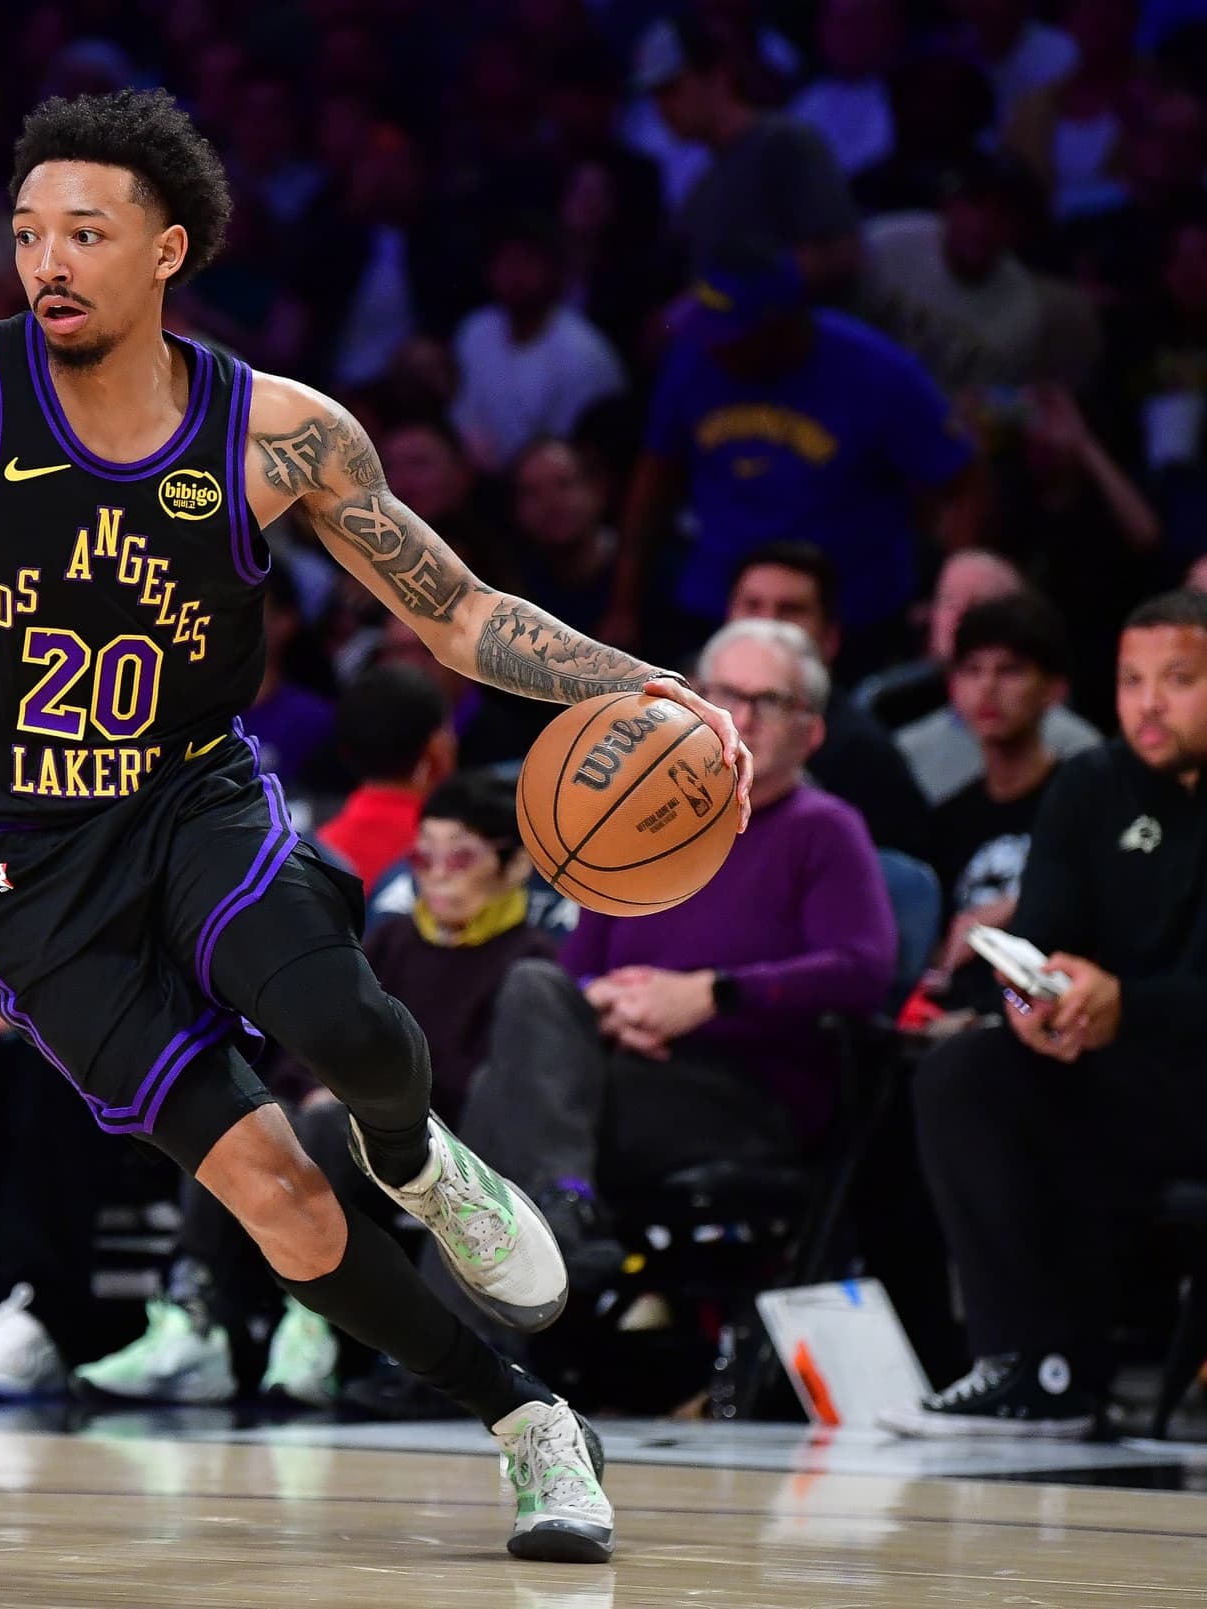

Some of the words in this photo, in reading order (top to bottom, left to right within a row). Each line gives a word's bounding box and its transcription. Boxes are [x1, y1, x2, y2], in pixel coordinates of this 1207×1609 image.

[165, 481, 218, 507] bibigo
[173, 499, 196, 509] 비비고
[65, 505, 213, 663] ANGELES
[16, 626, 164, 741] 20
[573, 702, 683, 791] Wilson
